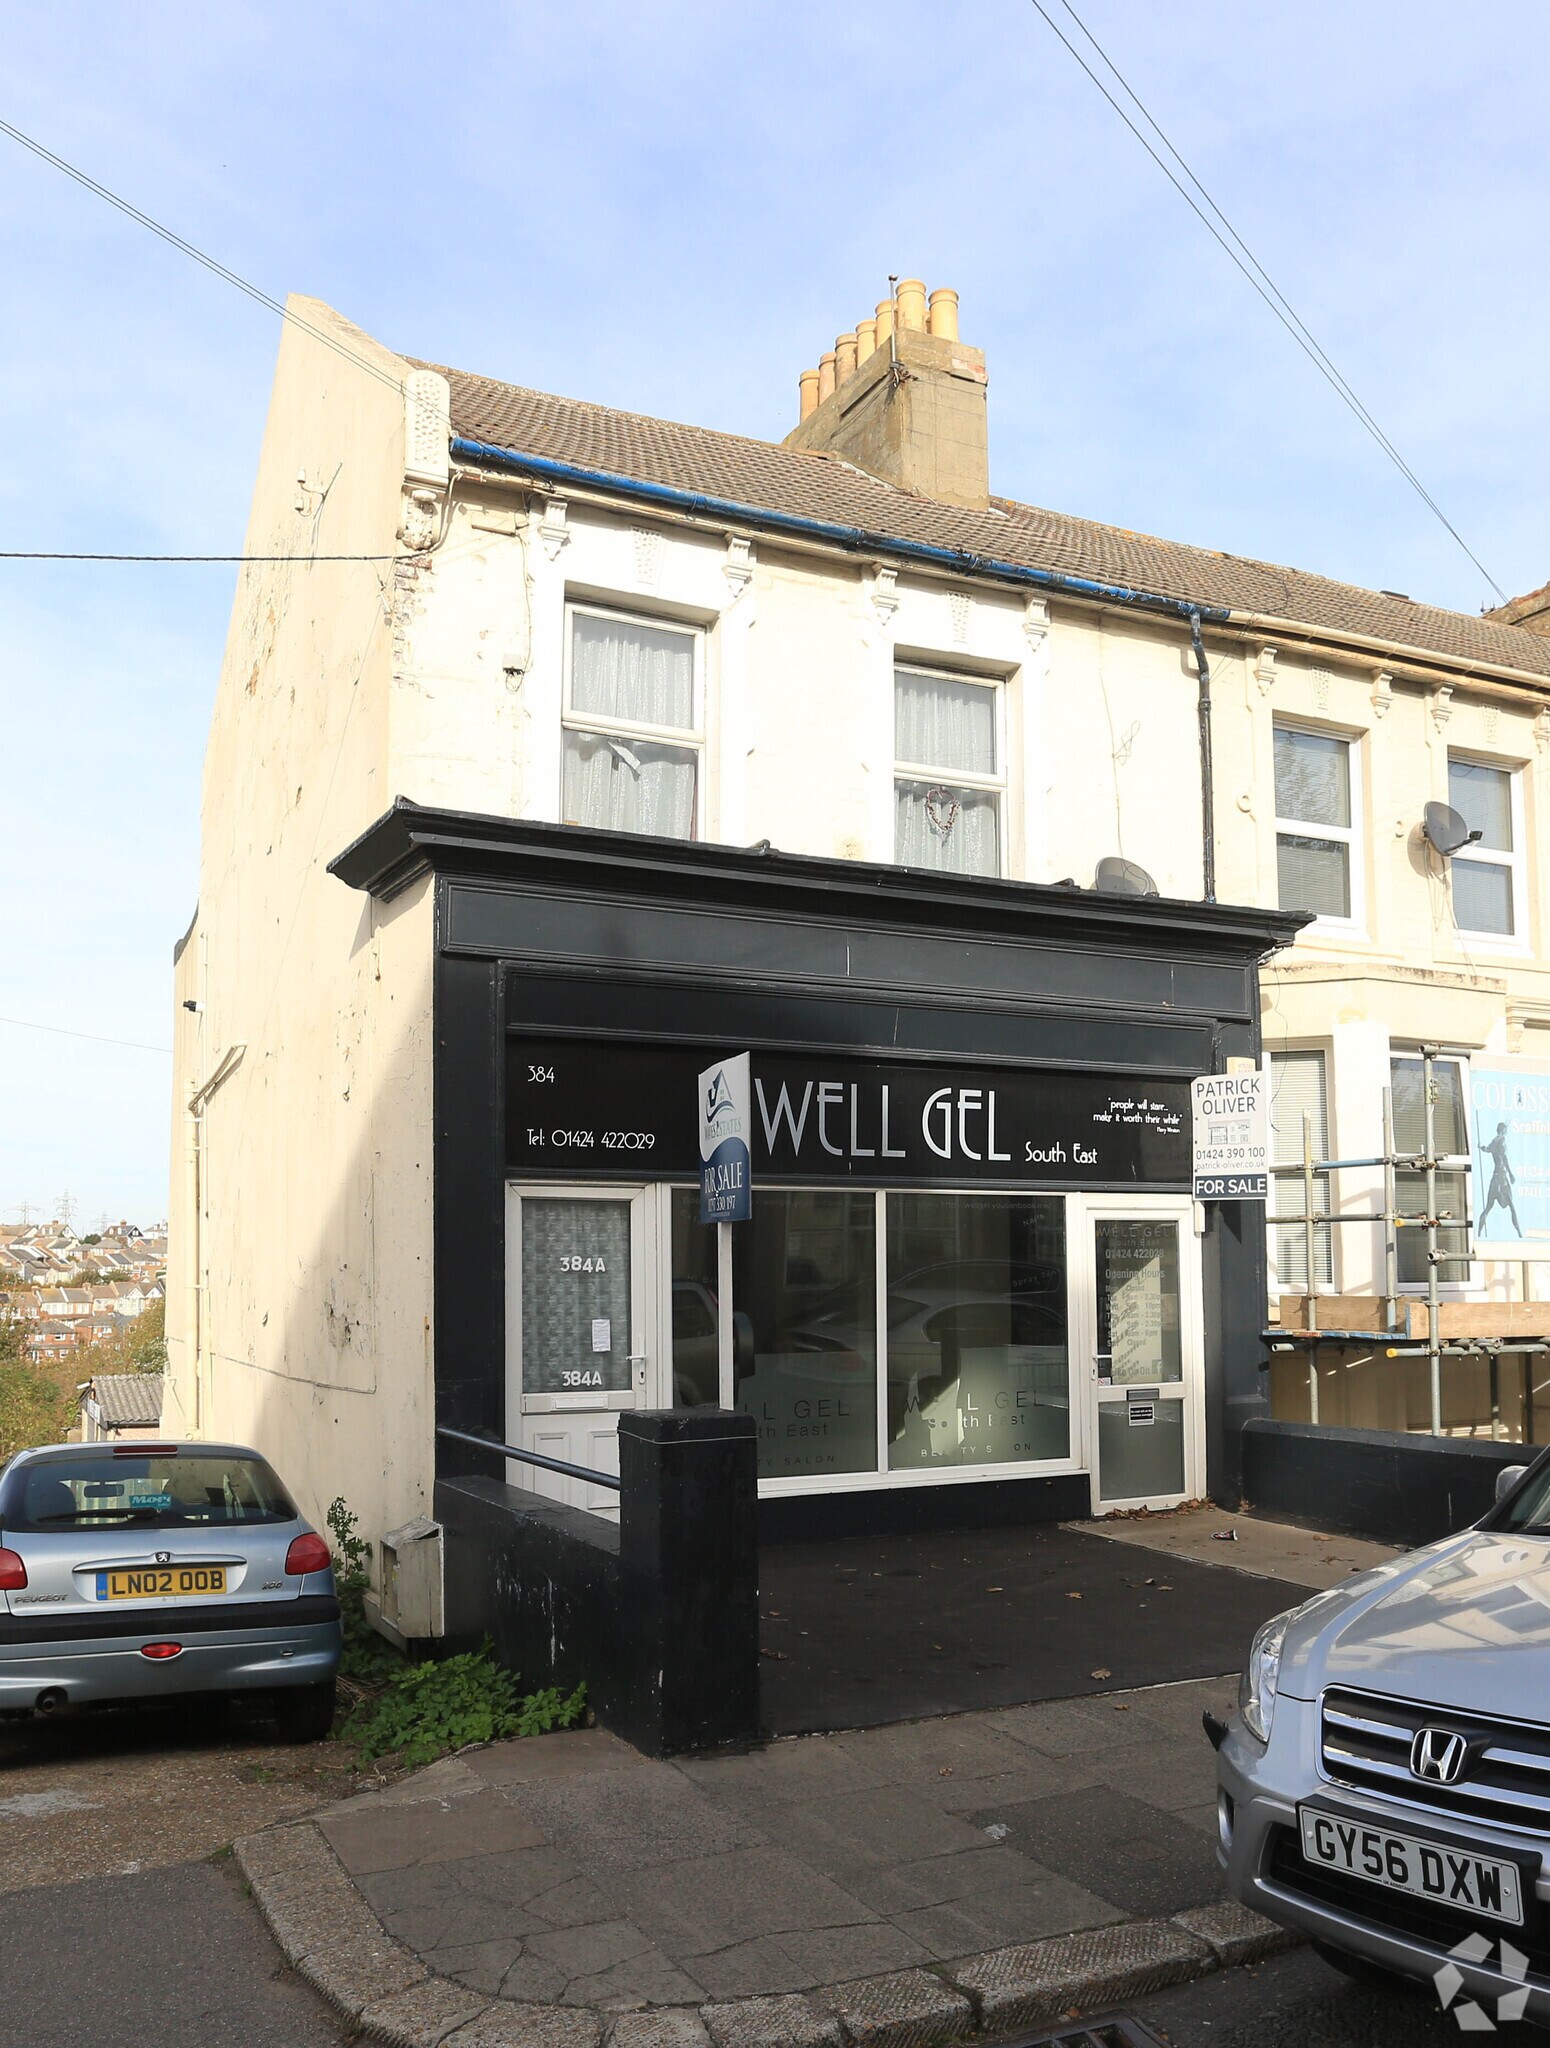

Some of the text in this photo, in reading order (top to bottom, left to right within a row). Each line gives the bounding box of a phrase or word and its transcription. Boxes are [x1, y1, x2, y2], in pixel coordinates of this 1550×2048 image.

[527, 1065, 555, 1083] 384
[1196, 1078, 1260, 1098] PATRICK
[1137, 1099, 1148, 1109] will
[1202, 1097, 1256, 1115] OLIVER
[1472, 1081, 1550, 1115] COLOSS
[754, 1078, 1011, 1161] WELL GEL
[1093, 1110, 1112, 1122] make
[1115, 1114, 1120, 1122] it
[1122, 1112, 1142, 1123] worth
[1145, 1112, 1160, 1123] their
[526, 1128, 655, 1149] Tel: 01424 422029
[1024, 1141, 1098, 1164] South East
[1196, 1147, 1265, 1160] 01424 390 100
[1196, 1159, 1266, 1170] patrick-oliver.co.uk
[717, 1162, 742, 1191] SALE
[1196, 1178, 1266, 1194] FOR SALE
[1099, 1226, 1169, 1237] WELL GEL
[1105, 1248, 1165, 1259] 01424 422029
[559, 1255, 606, 1273] 384A
[1105, 1268, 1165, 1280] Opening Hours
[561, 1370, 602, 1387] 384A
[995, 1390, 1044, 1409] GEL
[794, 1399, 850, 1419] GEL
[787, 1423, 829, 1437] East
[928, 1415, 979, 1428] Soth
[111, 1571, 173, 1595] LN02
[260, 1581, 283, 1590] 206
[14, 1593, 68, 1604] PEUGEOT
[1314, 1819, 1502, 1913] GY56 DXW
